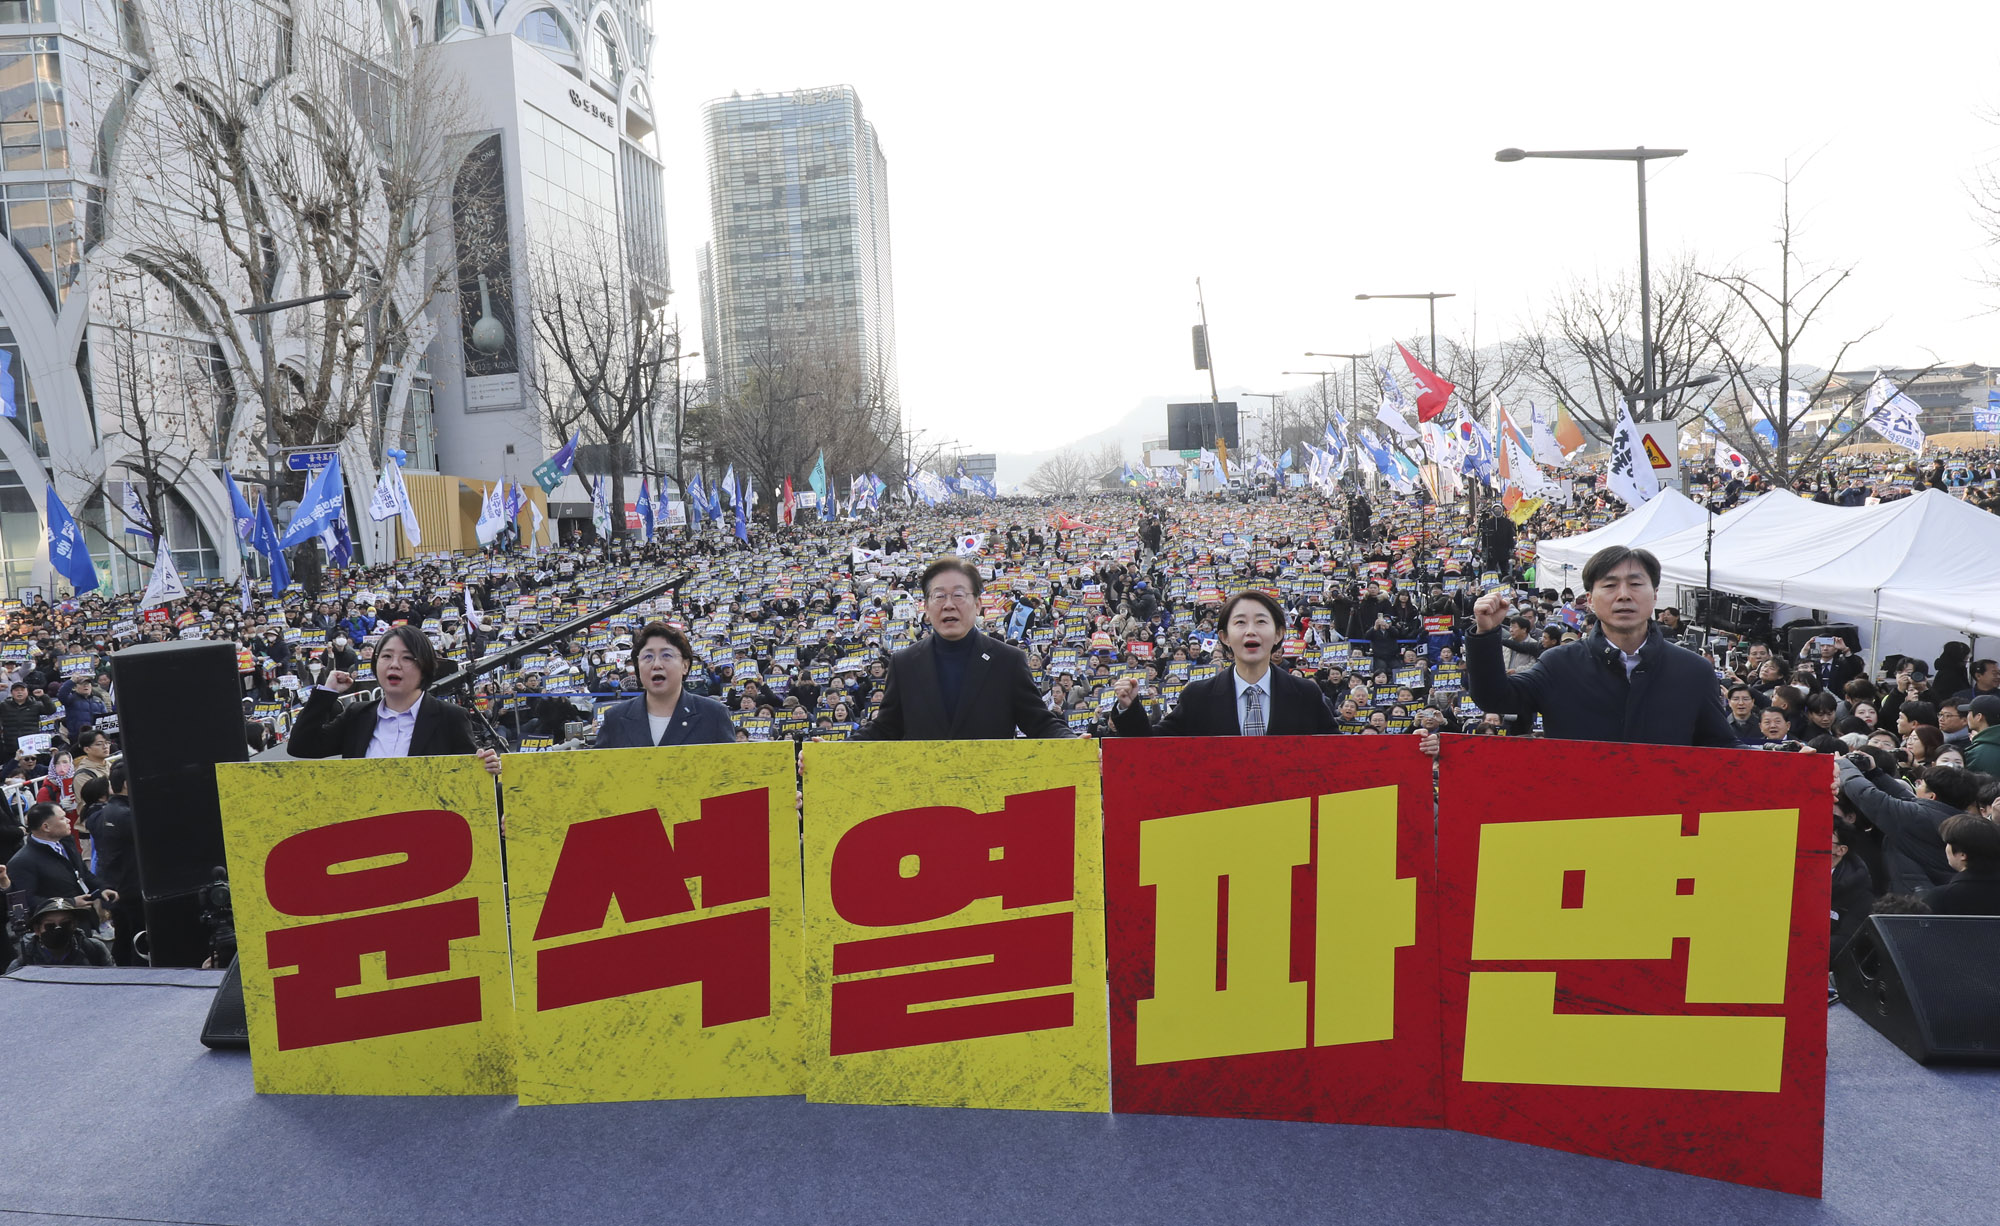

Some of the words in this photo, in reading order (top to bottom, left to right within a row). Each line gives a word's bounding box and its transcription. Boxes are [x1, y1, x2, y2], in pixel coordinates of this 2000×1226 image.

[791, 86, 844, 106] 서울경제
[1872, 407, 1913, 435] 용산
[1337, 649, 1348, 657] 수호
[61, 658, 77, 666] 내란
[62, 664, 76, 672] 민주
[265, 786, 1076, 1057] 윤석열
[1135, 785, 1800, 1093] 파면
